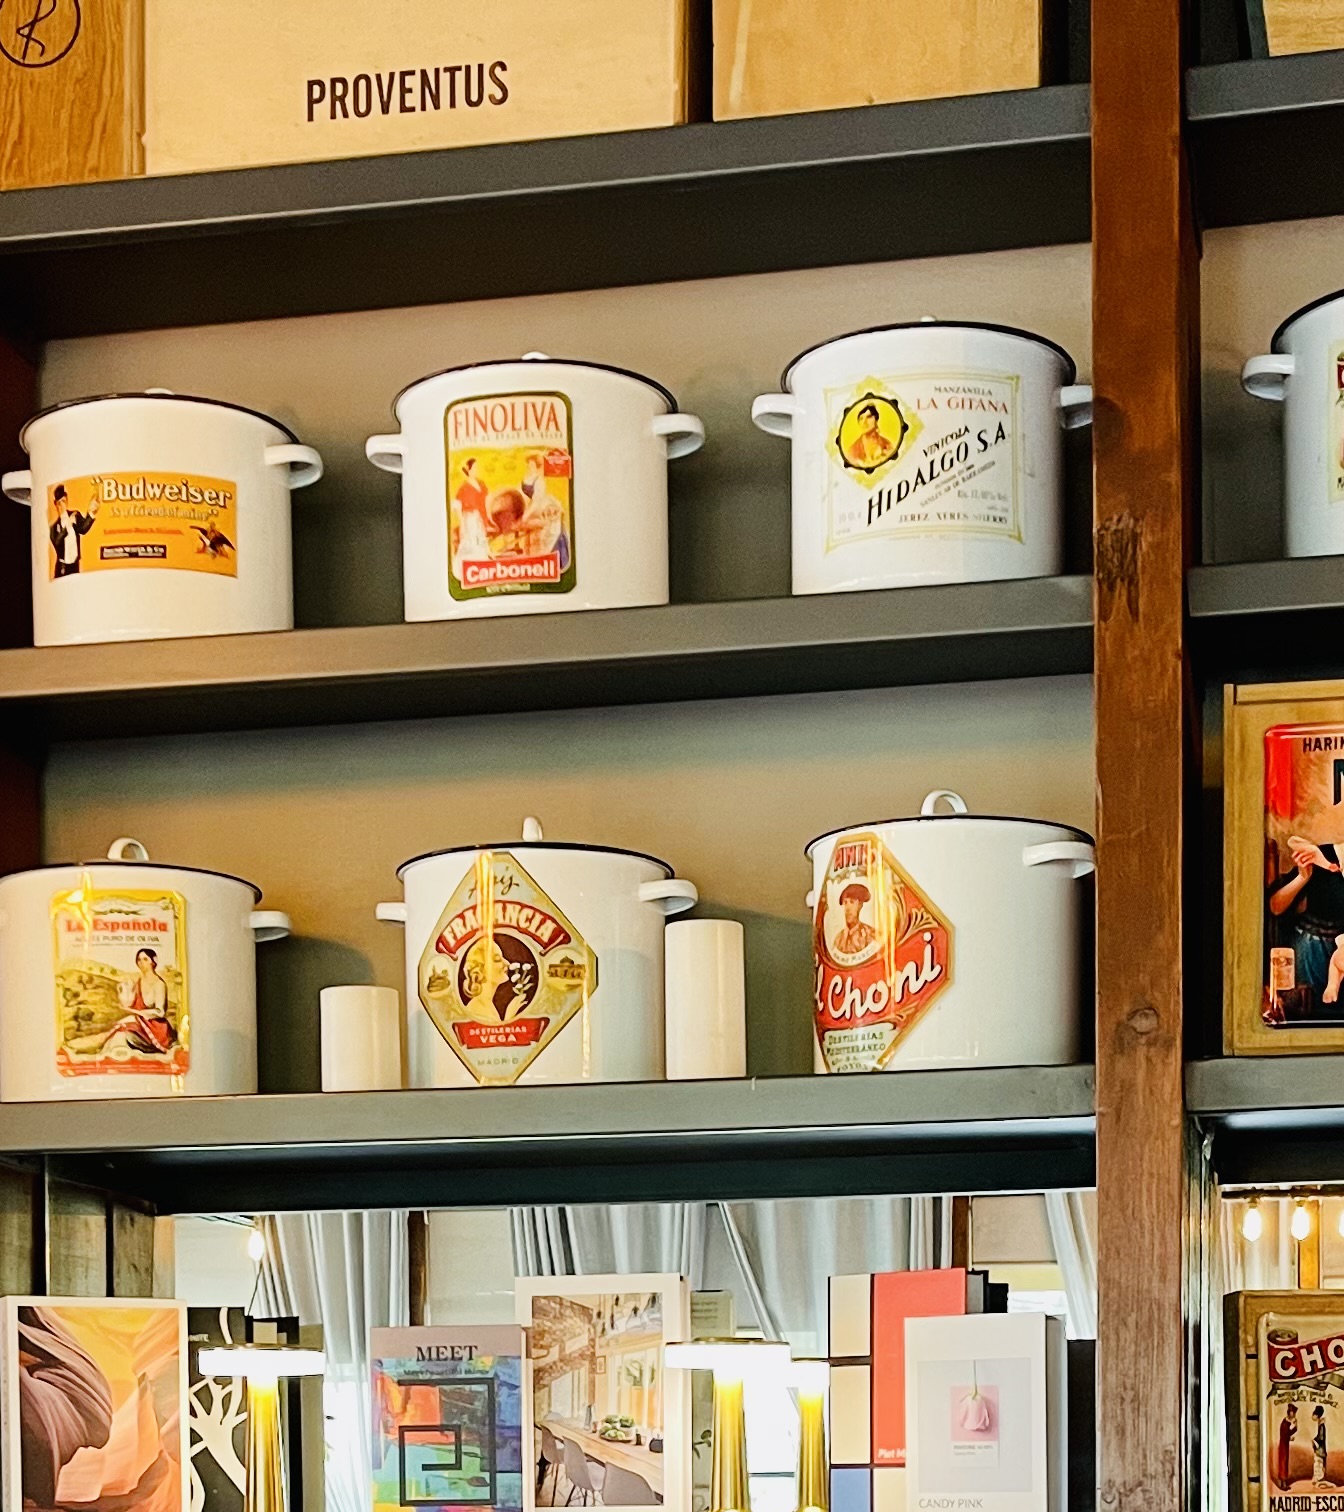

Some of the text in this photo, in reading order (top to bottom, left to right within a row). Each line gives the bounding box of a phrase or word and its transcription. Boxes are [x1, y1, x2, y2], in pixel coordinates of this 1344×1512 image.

[305, 60, 510, 123] PROVENTUS
[453, 400, 562, 441] FINOLIVA
[916, 397, 1009, 416] LA GITANA
[867, 441, 969, 527] HIDALGO
[465, 559, 556, 584] Carbonell
[443, 903, 558, 946] FRAANCIA
[827, 930, 943, 1021] Choni
[480, 1032, 518, 1044] VEGA
[415, 1344, 479, 1362] MEET
[918, 1498, 984, 1510] CANDY PINK
